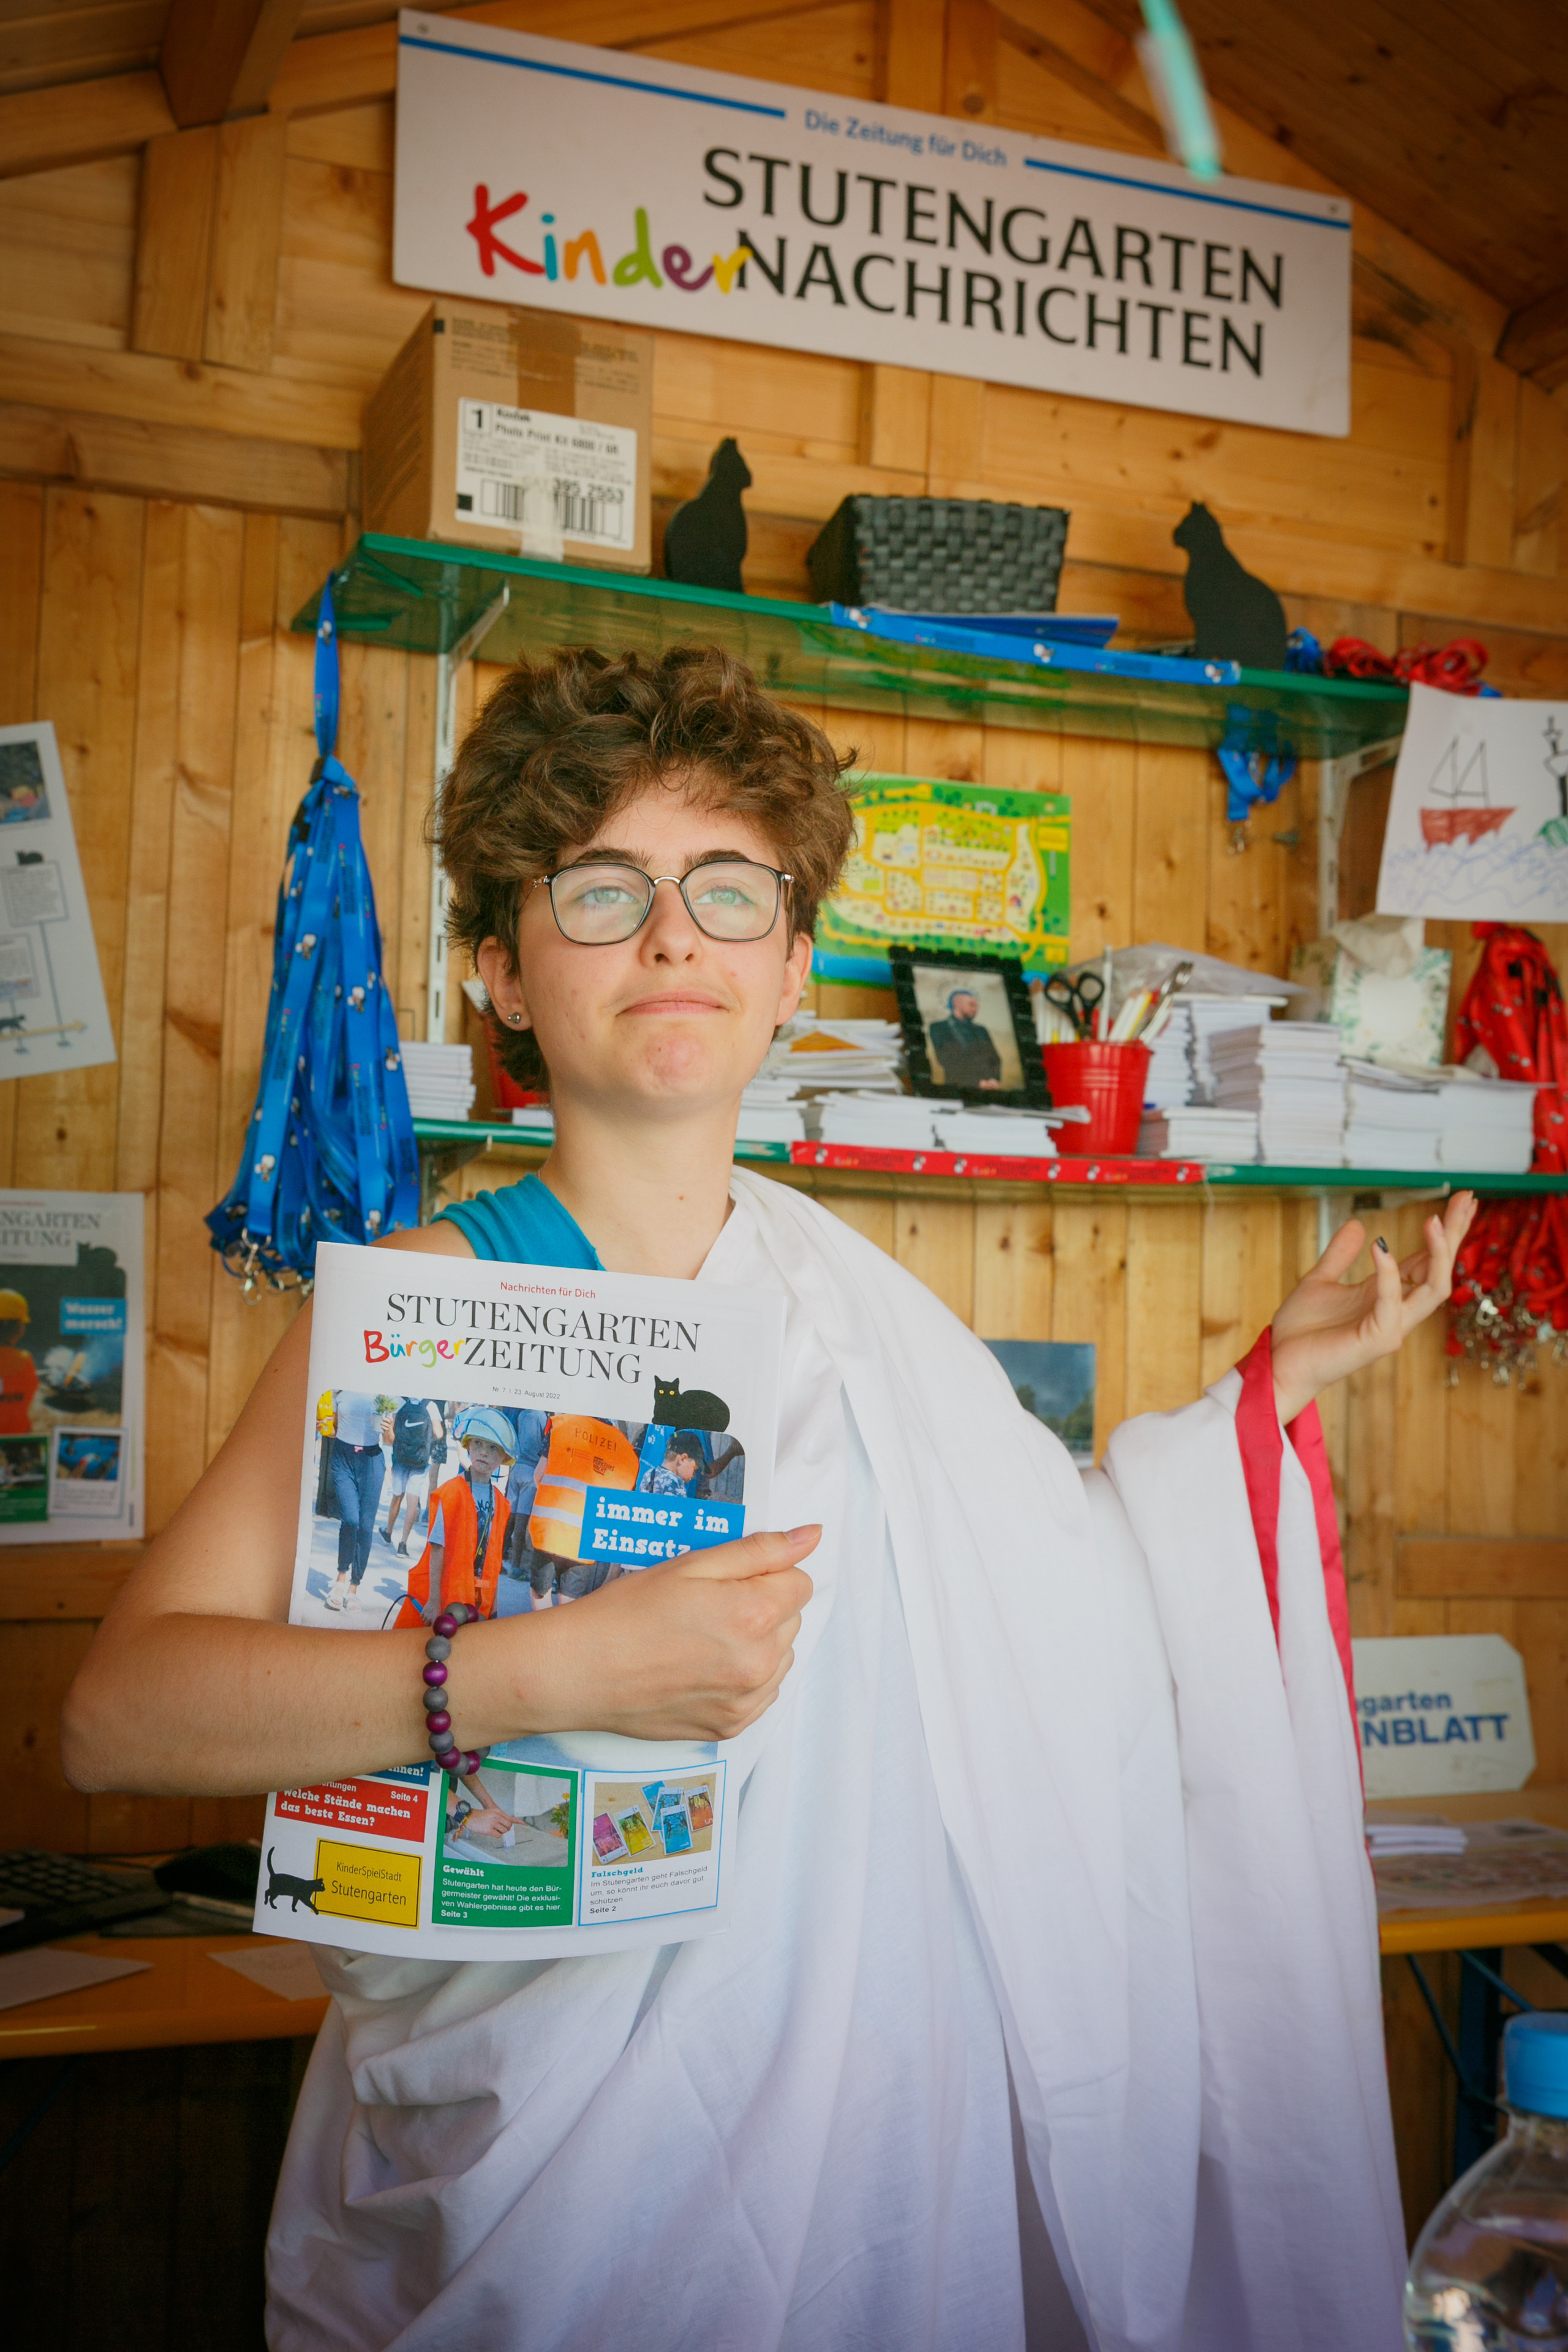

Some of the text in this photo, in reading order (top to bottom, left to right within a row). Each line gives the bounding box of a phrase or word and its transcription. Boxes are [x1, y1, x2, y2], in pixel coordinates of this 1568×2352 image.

[805, 109, 1008, 166] Die Zeitung für Dich
[703, 146, 1283, 311] STUTENGARTEN
[471, 409, 484, 429] 1
[497, 408, 531, 423] Kodak
[0, 1210, 102, 1229] NGARTEN
[0, 1229, 71, 1247] ITUNG
[500, 1281, 596, 1299] Nachrichten für Dich
[387, 1293, 703, 1352] STUTENGARTEN
[575, 1427, 617, 1452] POLIZEI
[595, 1496, 729, 1533] immer im
[592, 1528, 691, 1558] Einsatz
[1363, 1713, 1509, 1746] NBLATT
[388, 1765, 424, 1777] nnen!
[284, 1789, 410, 1819] Welche Stände machen
[390, 1790, 411, 1802] Seite
[281, 1801, 375, 1826] das beste Essen?
[337, 1861, 402, 1882] KinderSpielStadt
[442, 1864, 484, 1877] Gewählt
[591, 1867, 643, 1878] Falschgeld
[602, 1875, 649, 1887] Stutengarten
[651, 1872, 668, 1882] geht
[669, 1866, 708, 1878] Falschgeld
[331, 1880, 406, 1905] Stutengarten
[442, 1878, 489, 1890] Stutengarten
[617, 1885, 638, 1894] könnt
[670, 1878, 690, 1887] davor
[441, 1890, 481, 1899] germeister
[440, 1909, 461, 1918] Seite
[456, 1901, 517, 1912] Wahlergebnisse
